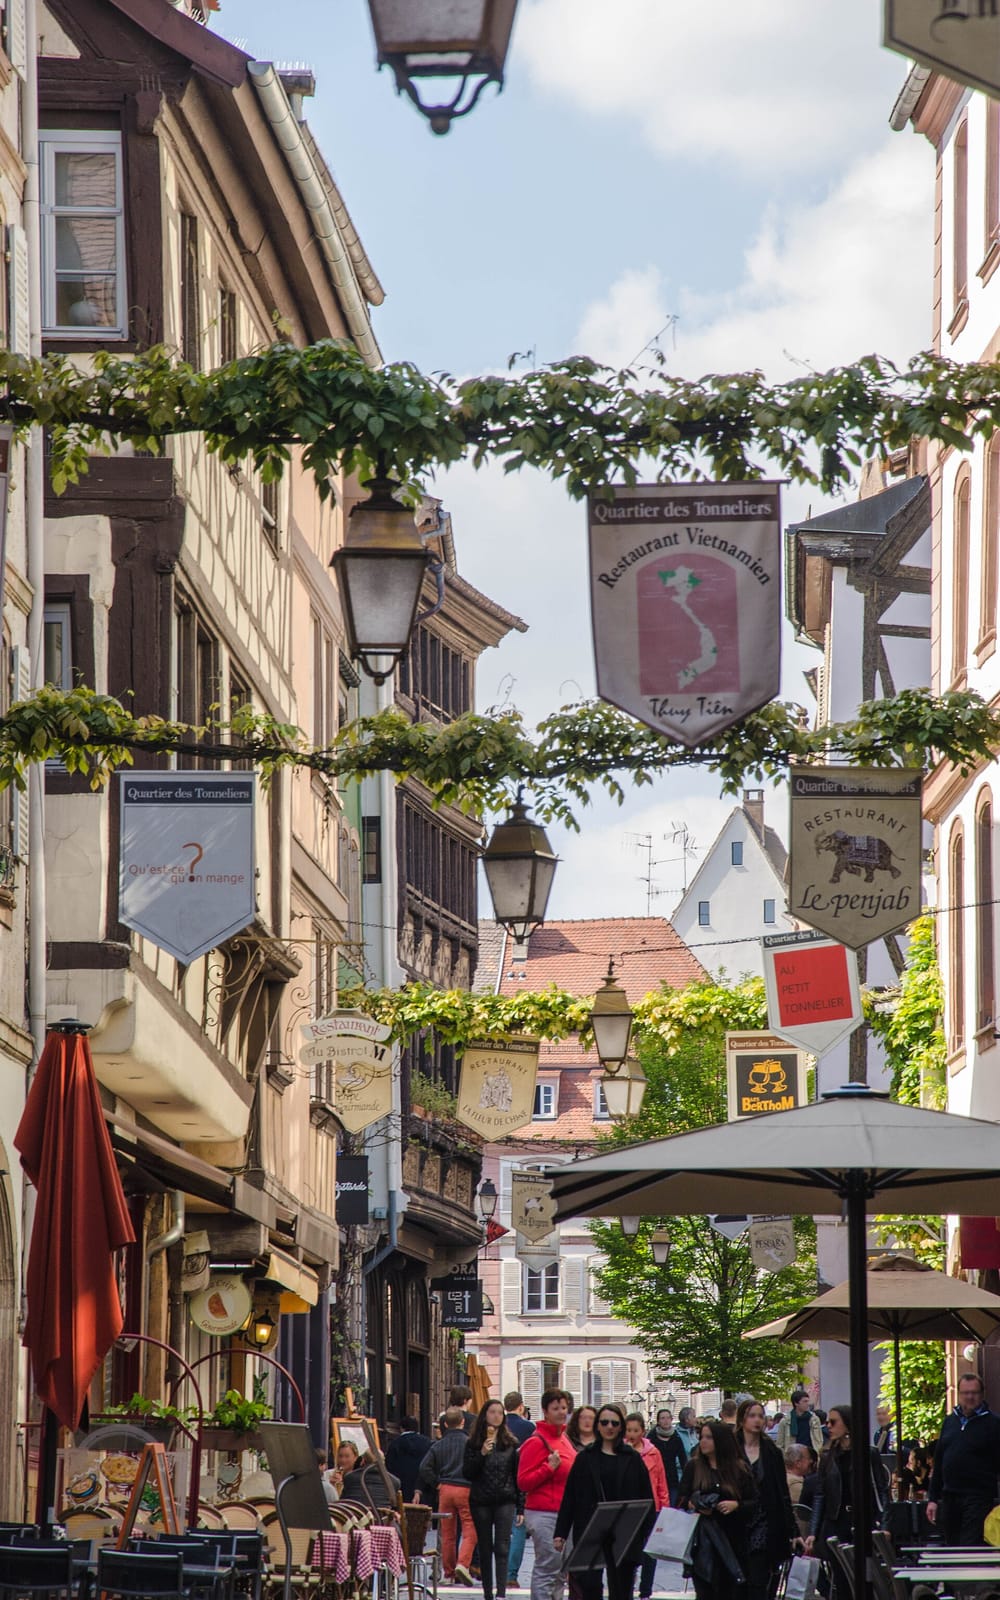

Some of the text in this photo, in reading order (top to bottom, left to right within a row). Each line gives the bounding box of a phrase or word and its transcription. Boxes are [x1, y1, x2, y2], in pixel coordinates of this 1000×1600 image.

[595, 500, 773, 522] Quartier des Tonneliers
[598, 526, 771, 590] Restaurant Vietnamien
[649, 696, 734, 724] Thuy Tiên
[127, 786, 250, 800] Quartier des Tonneliers
[796, 778, 839, 793] Quartier
[804, 807, 908, 834] RESTAURANT
[128, 864, 185, 876] Qu'est-ce
[206, 874, 245, 885] mange
[797, 884, 912, 918] Le penjab
[765, 934, 796, 946] Quartier
[797, 931, 811, 940] des
[780, 965, 795, 976] AU
[781, 981, 810, 995] PETIT
[783, 996, 844, 1014] TONNELIER
[310, 1019, 383, 1037] Restaurant
[730, 1039, 757, 1048] Quartier
[469, 1057, 528, 1075] RESTAURANT
